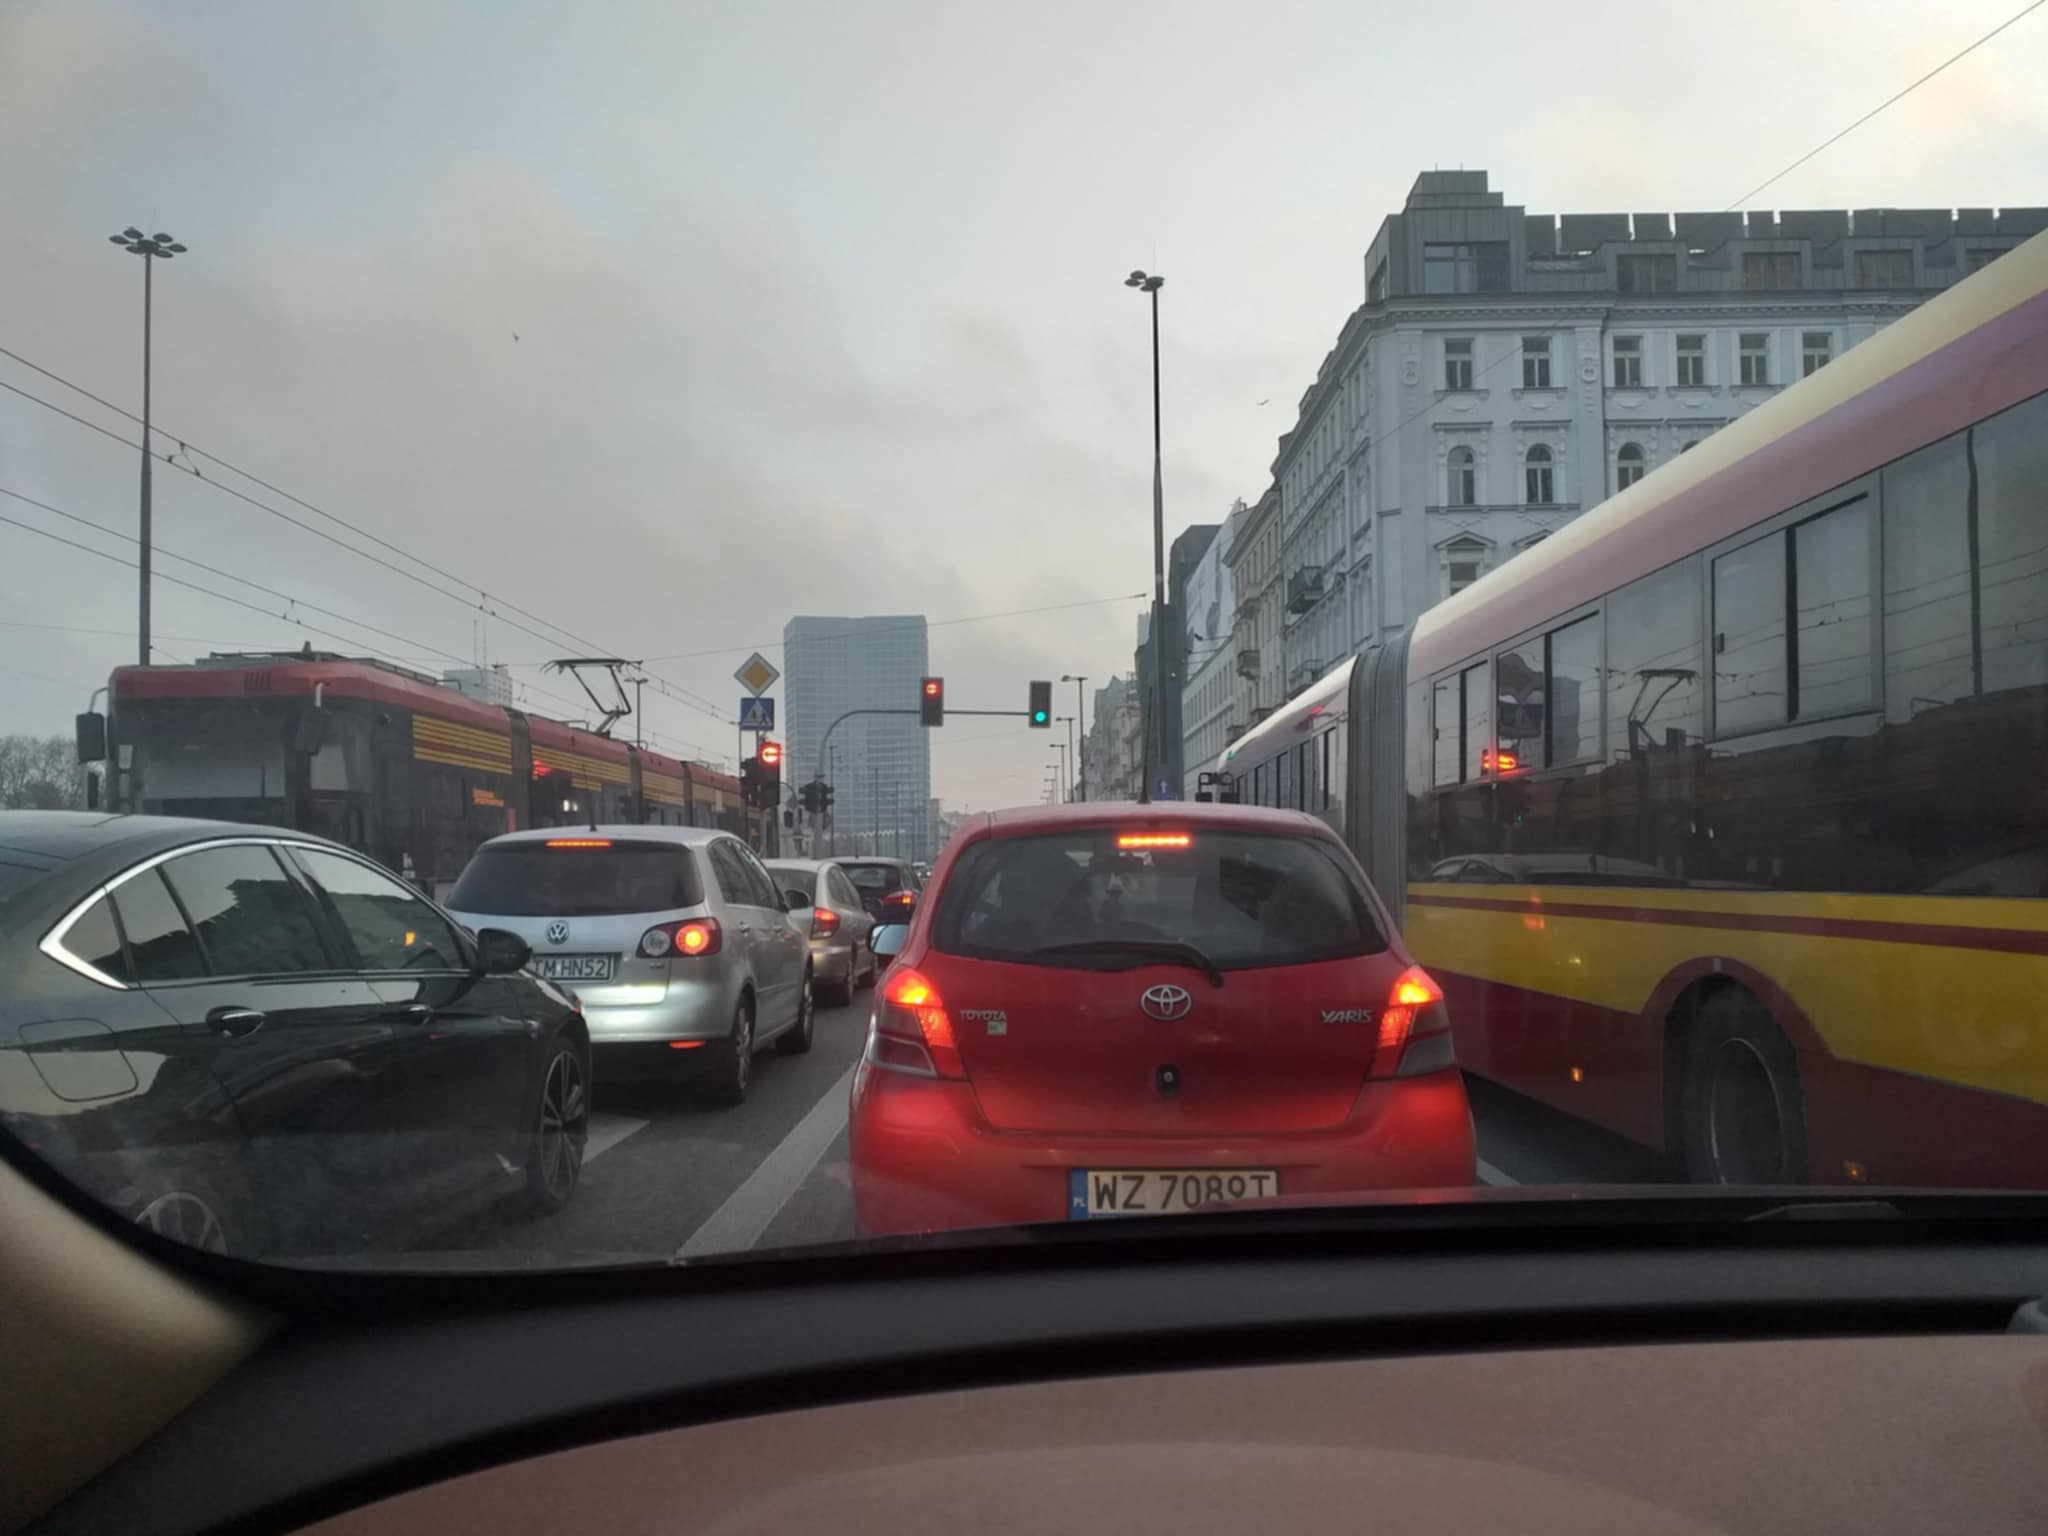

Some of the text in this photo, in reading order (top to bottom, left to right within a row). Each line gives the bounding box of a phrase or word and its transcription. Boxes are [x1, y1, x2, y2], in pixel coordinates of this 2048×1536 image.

[560, 959, 607, 977] HN52
[960, 1009, 1007, 1021] TOYOTA
[1094, 1174, 1271, 1210] WZ 7089T
